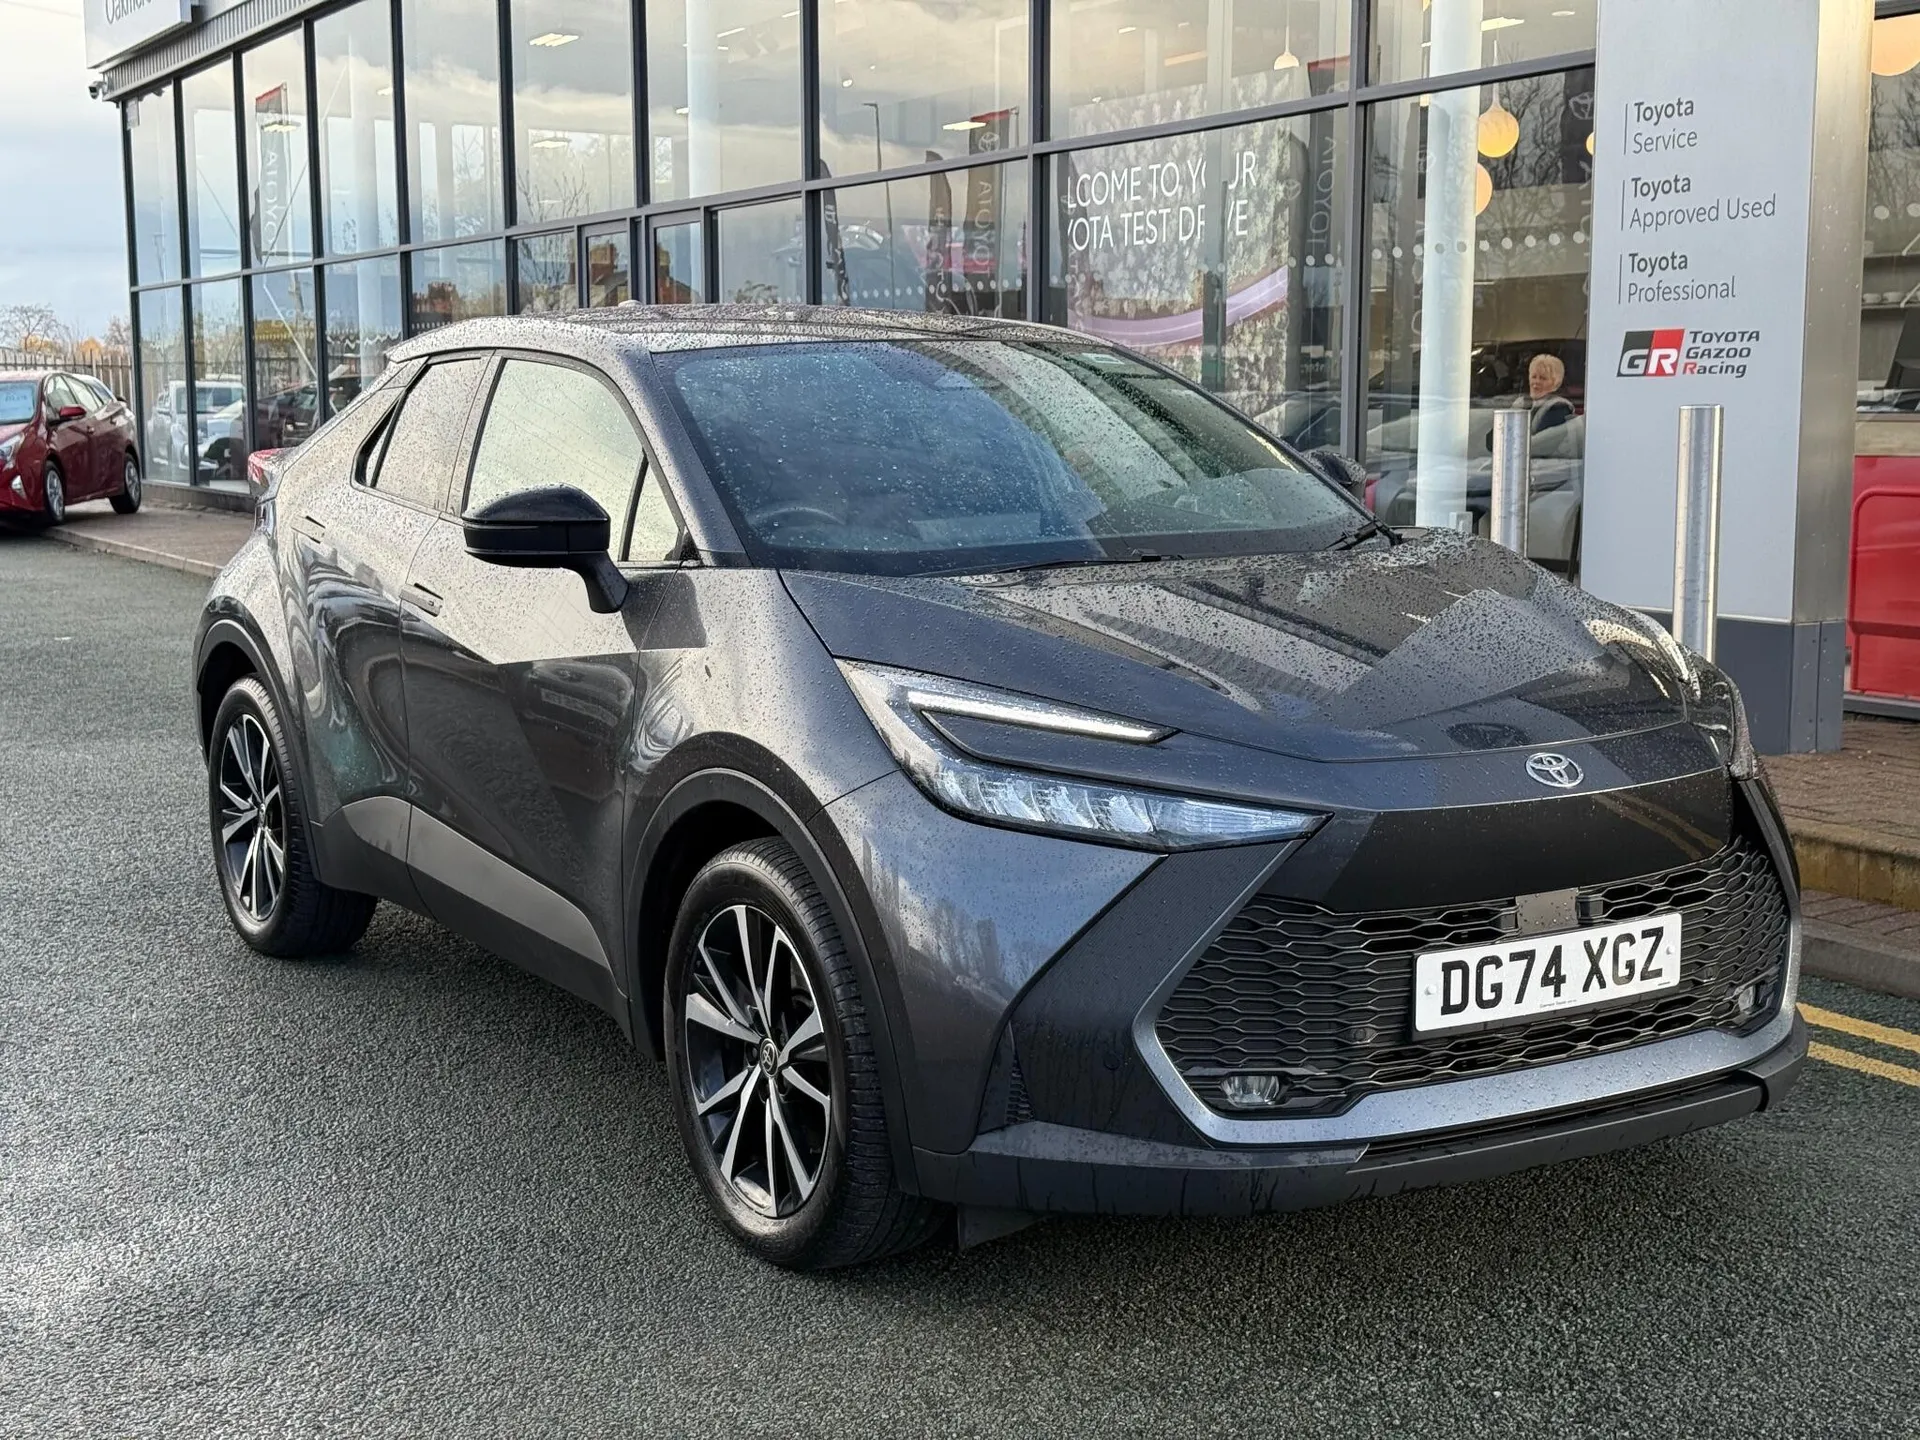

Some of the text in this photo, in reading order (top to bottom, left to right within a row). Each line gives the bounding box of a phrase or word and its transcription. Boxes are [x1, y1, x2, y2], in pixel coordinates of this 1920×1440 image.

[1634, 97, 1694, 126] Toyota
[1632, 128, 1698, 154] Service
[1149, 161, 1180, 200] TO
[1631, 174, 1691, 201] Toyota
[1629, 193, 1777, 233] Approved Used
[1121, 208, 1172, 247] TEST
[1628, 251, 1688, 277] Toyota
[1627, 275, 1736, 303] Professional
[1689, 330, 1760, 344] TOYOTA
[1619, 348, 1678, 376] GR
[1685, 347, 1752, 360] GAZOO
[1682, 361, 1747, 379] Racing
[1440, 926, 1665, 1016] DG74 XGZ
